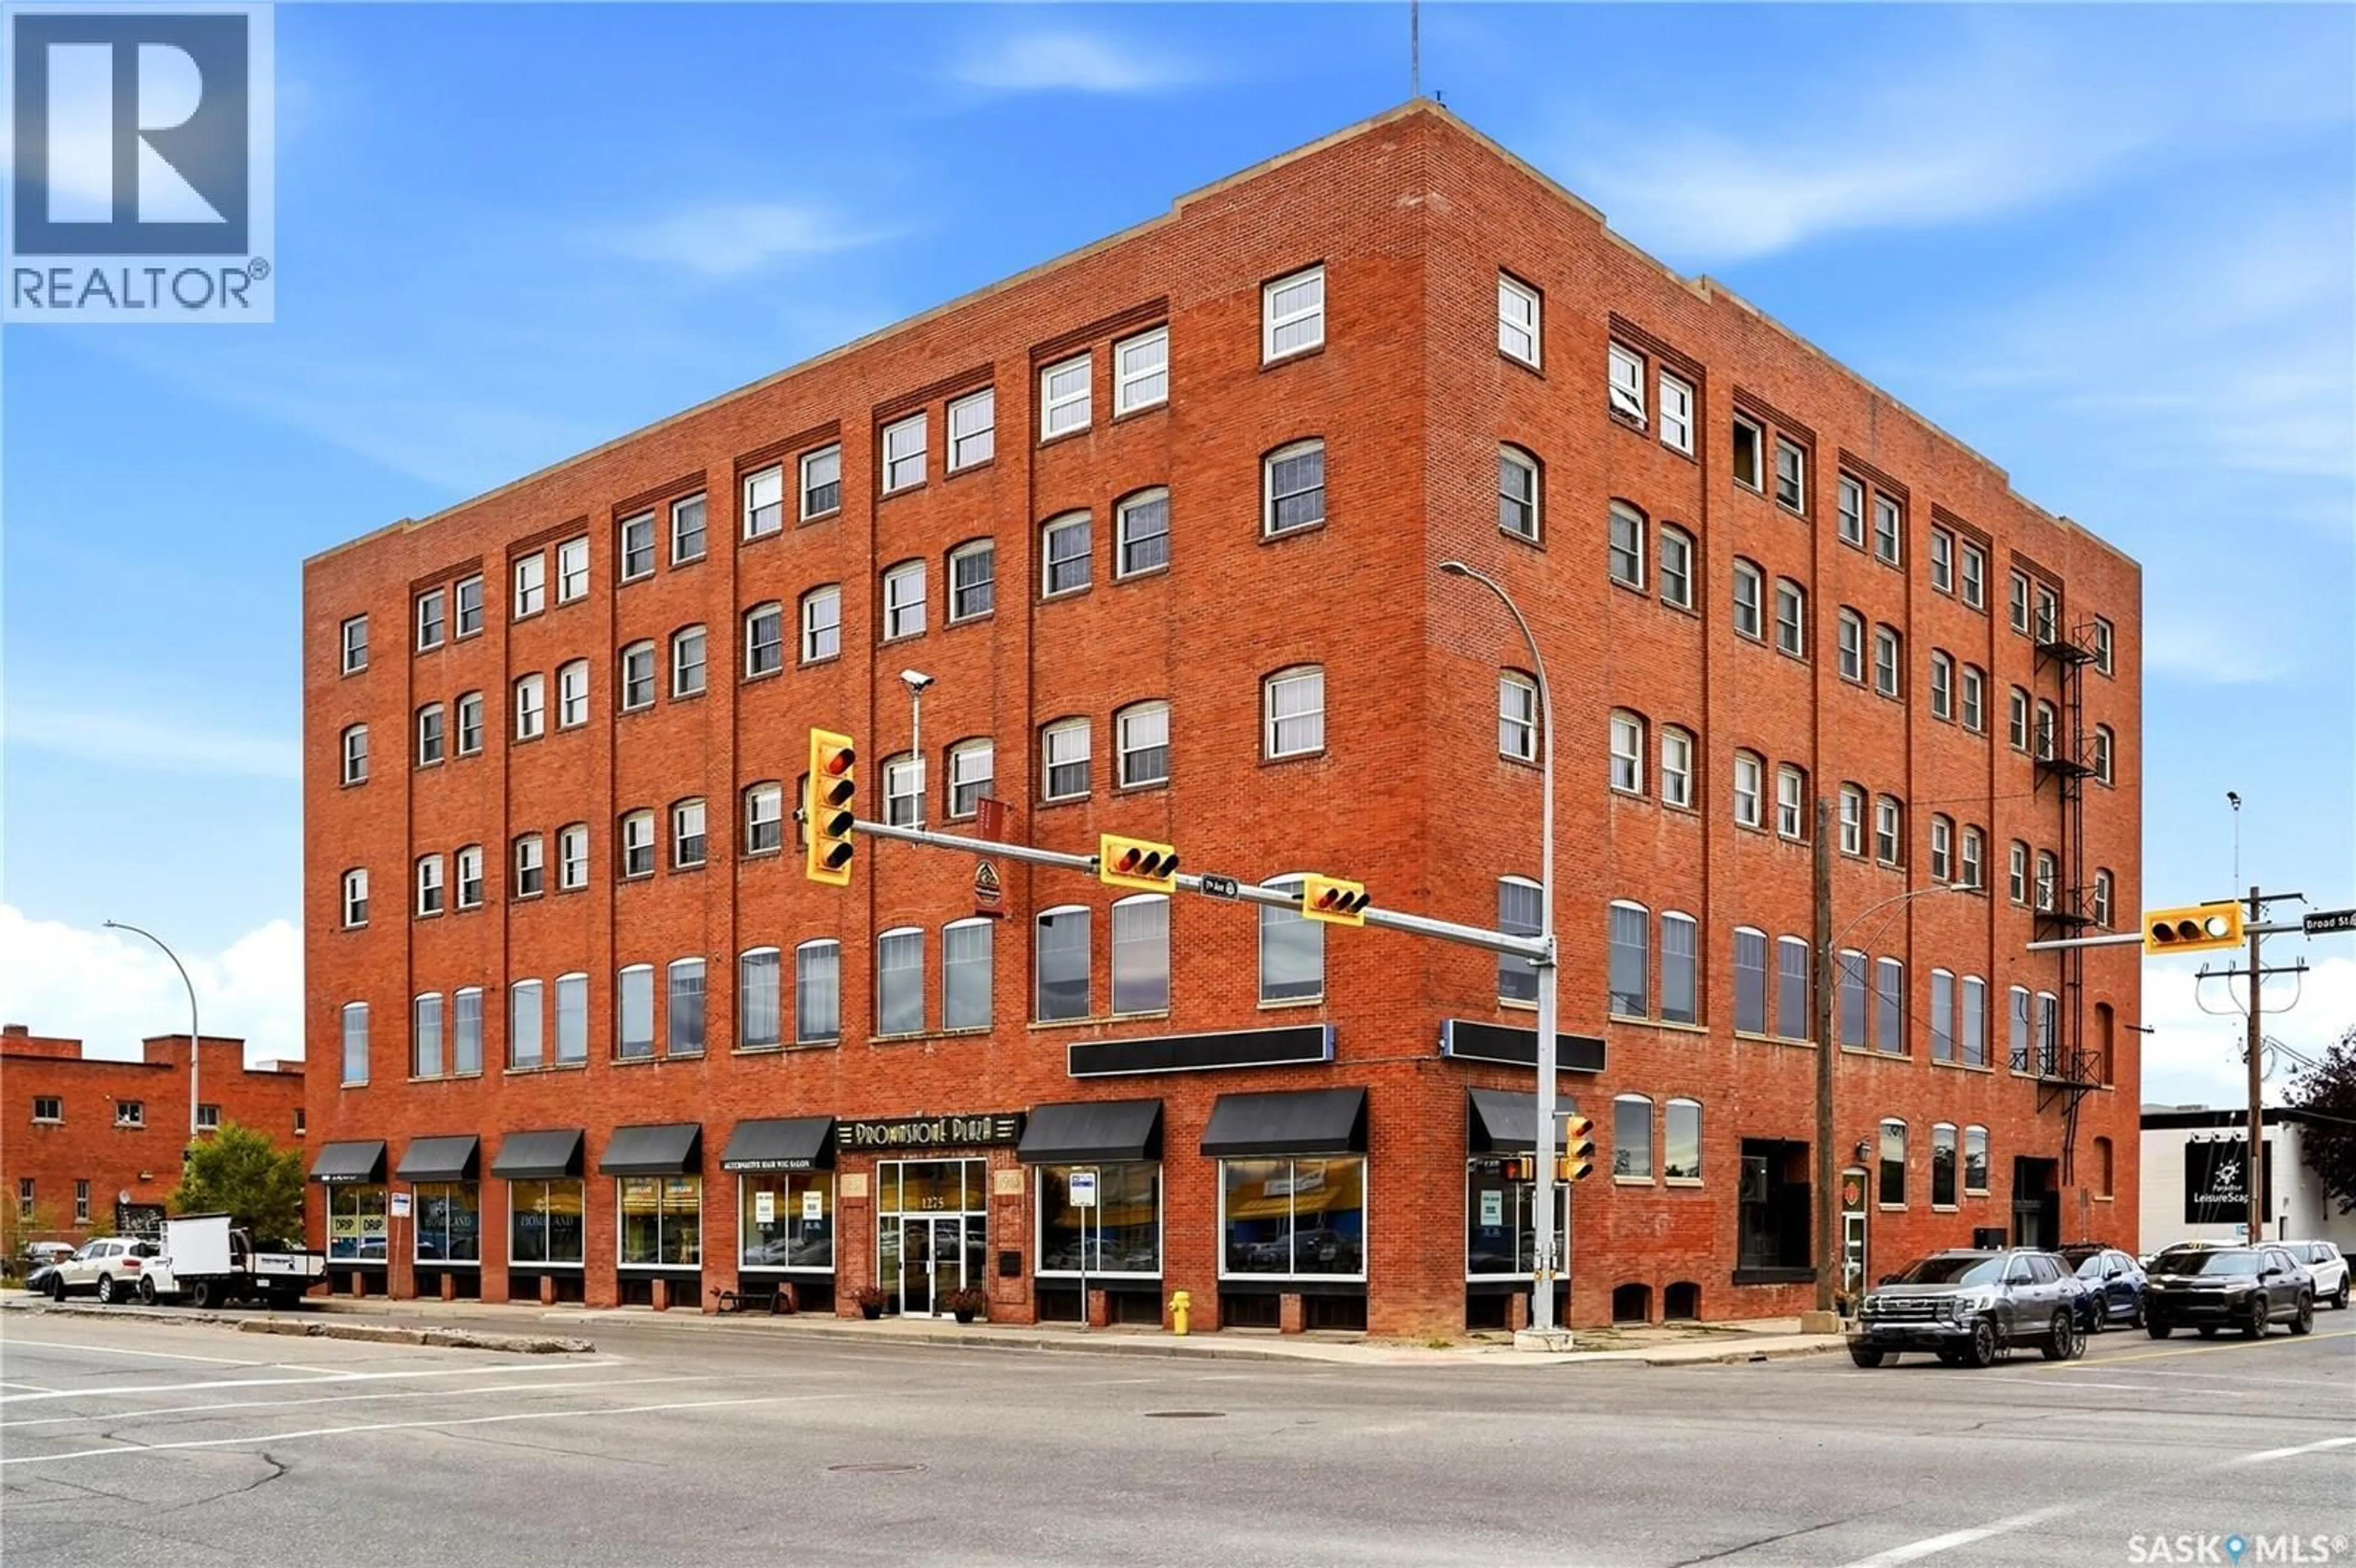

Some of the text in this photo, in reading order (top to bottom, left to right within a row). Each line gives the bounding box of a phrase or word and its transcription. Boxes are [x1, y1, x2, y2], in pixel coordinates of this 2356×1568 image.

[2306, 917, 2335, 930] Broad
[922, 1197, 944, 1209] 1275
[2193, 1192, 2249, 1204] LeisureScap
